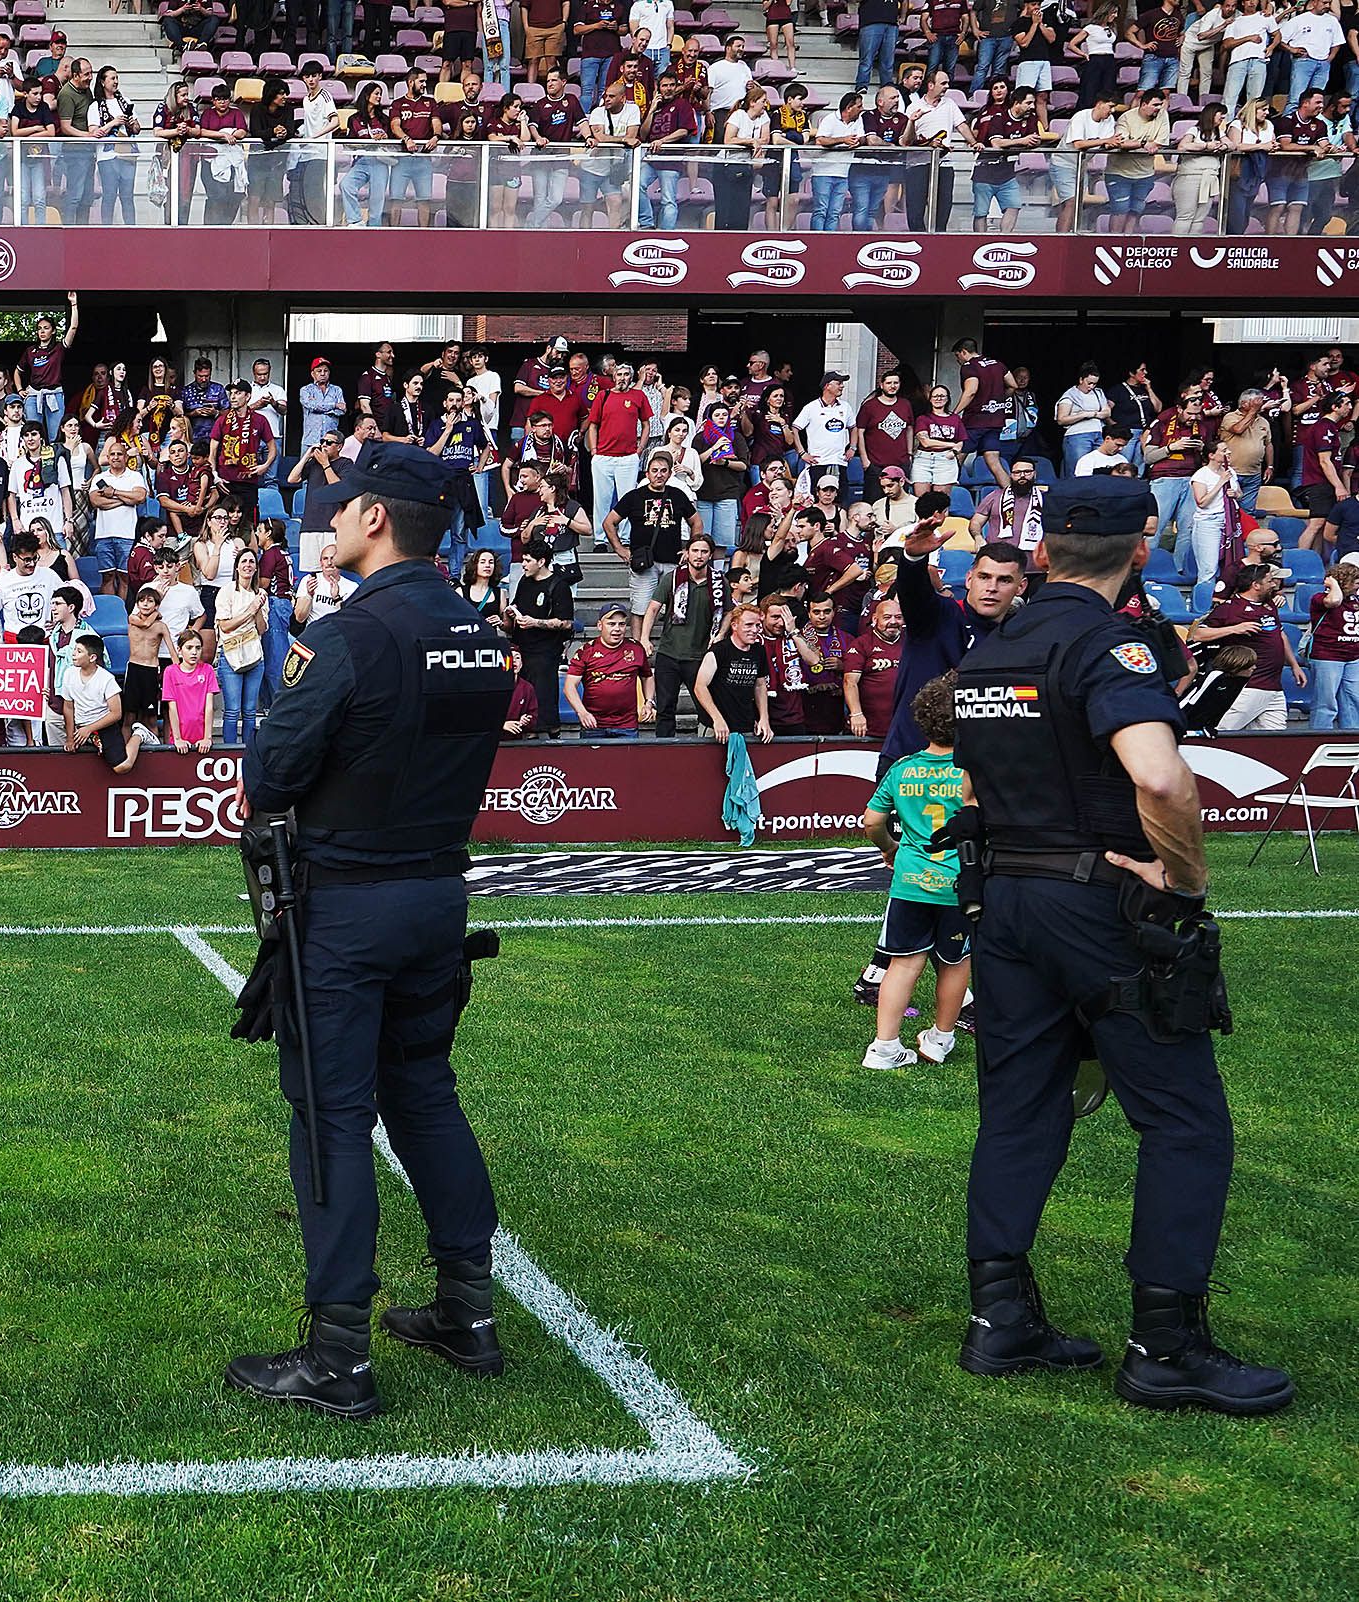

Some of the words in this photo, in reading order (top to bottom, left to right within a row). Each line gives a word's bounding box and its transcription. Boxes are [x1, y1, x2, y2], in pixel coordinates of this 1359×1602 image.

[1127, 247, 1178, 257] DEPORTE
[1228, 248, 1268, 258] GALICIA
[1126, 259, 1172, 269] GALEGO
[1227, 259, 1279, 269] SAUDABLE
[650, 266, 674, 276] PON
[768, 267, 792, 277] PON
[883, 268, 906, 278] PON
[999, 270, 1022, 280] PON
[20, 498, 54, 509] KEZO
[6, 651, 35, 664] UNA
[426, 650, 505, 670] POLICIA
[955, 687, 1016, 702] POLICIA
[955, 701, 1041, 718] NACIONAL
[196, 757, 243, 783] CO
[523, 765, 567, 780] CONSERVAS
[899, 783, 924, 797] EDU
[479, 786, 618, 812] PESCAMAR
